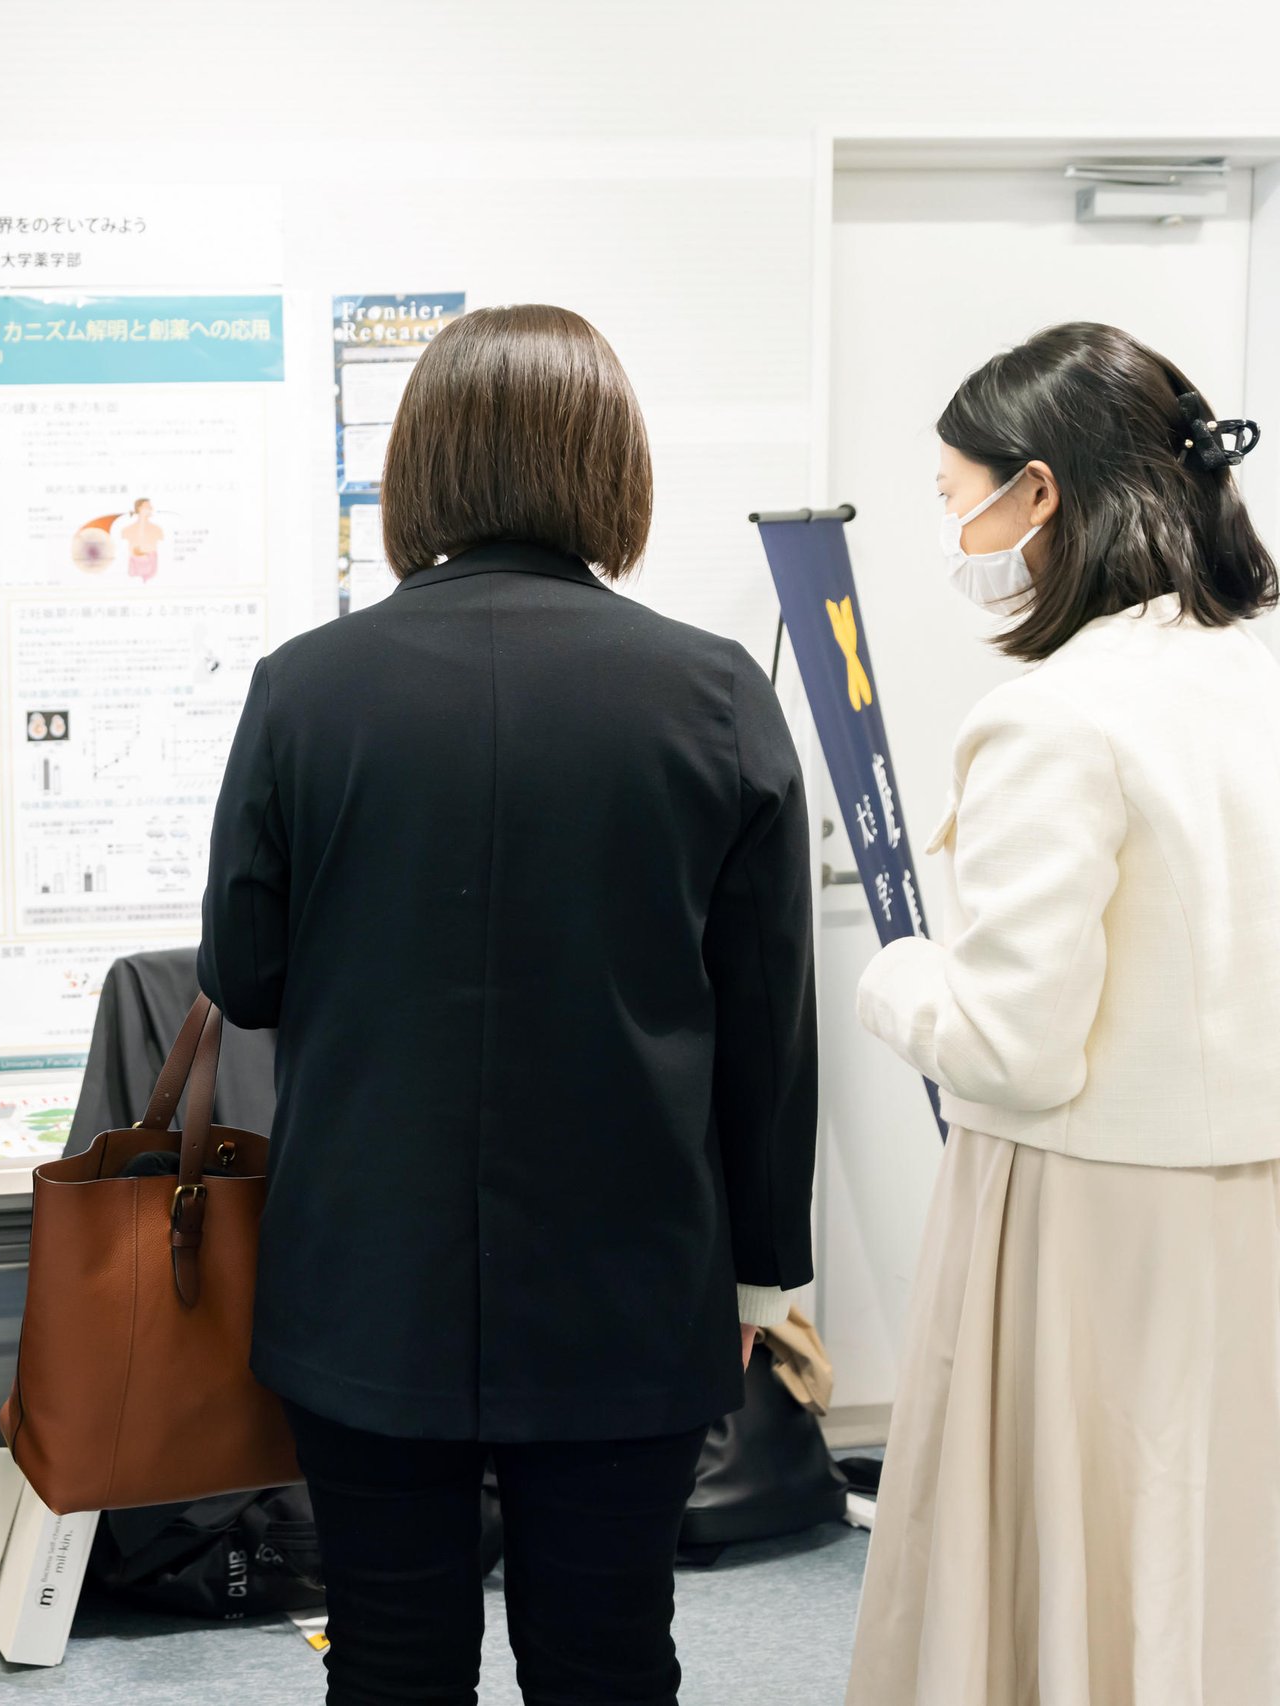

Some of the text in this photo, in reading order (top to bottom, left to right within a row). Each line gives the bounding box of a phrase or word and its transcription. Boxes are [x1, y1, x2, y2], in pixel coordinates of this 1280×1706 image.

[341, 301, 444, 322] Frontier
[227, 1550, 248, 1597] CLUB
[38, 1586, 56, 1608] m
